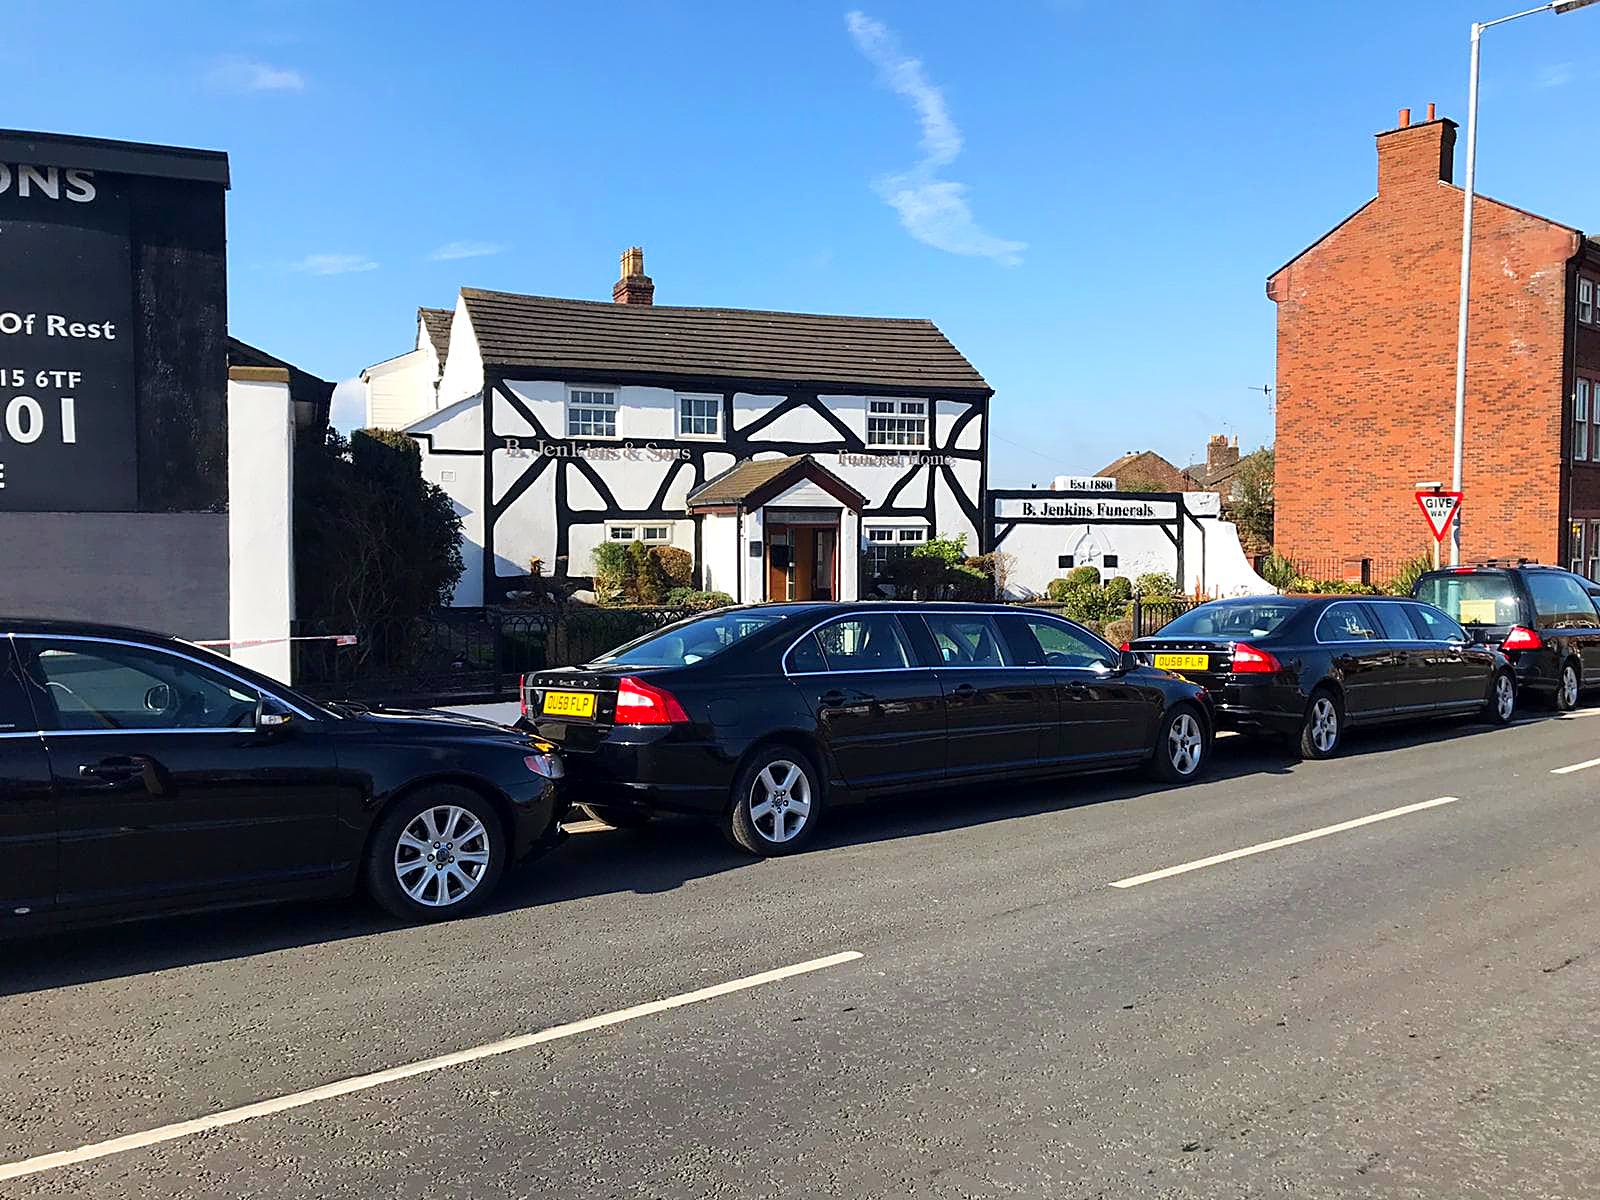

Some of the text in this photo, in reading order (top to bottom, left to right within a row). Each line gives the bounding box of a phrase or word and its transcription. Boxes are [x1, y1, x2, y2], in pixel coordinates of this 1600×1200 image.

[0, 312, 115, 340] Of Rest
[35, 370, 81, 389] 6TF
[624, 441, 641, 460] &
[646, 442, 691, 461] Sons
[907, 450, 954, 466] Home
[1089, 480, 1113, 490] 1880
[1023, 502, 1154, 517] B. Jenkins Funerals
[1426, 498, 1453, 508] GIVE
[1185, 657, 1204, 668] FLR
[571, 696, 589, 712] FLP
